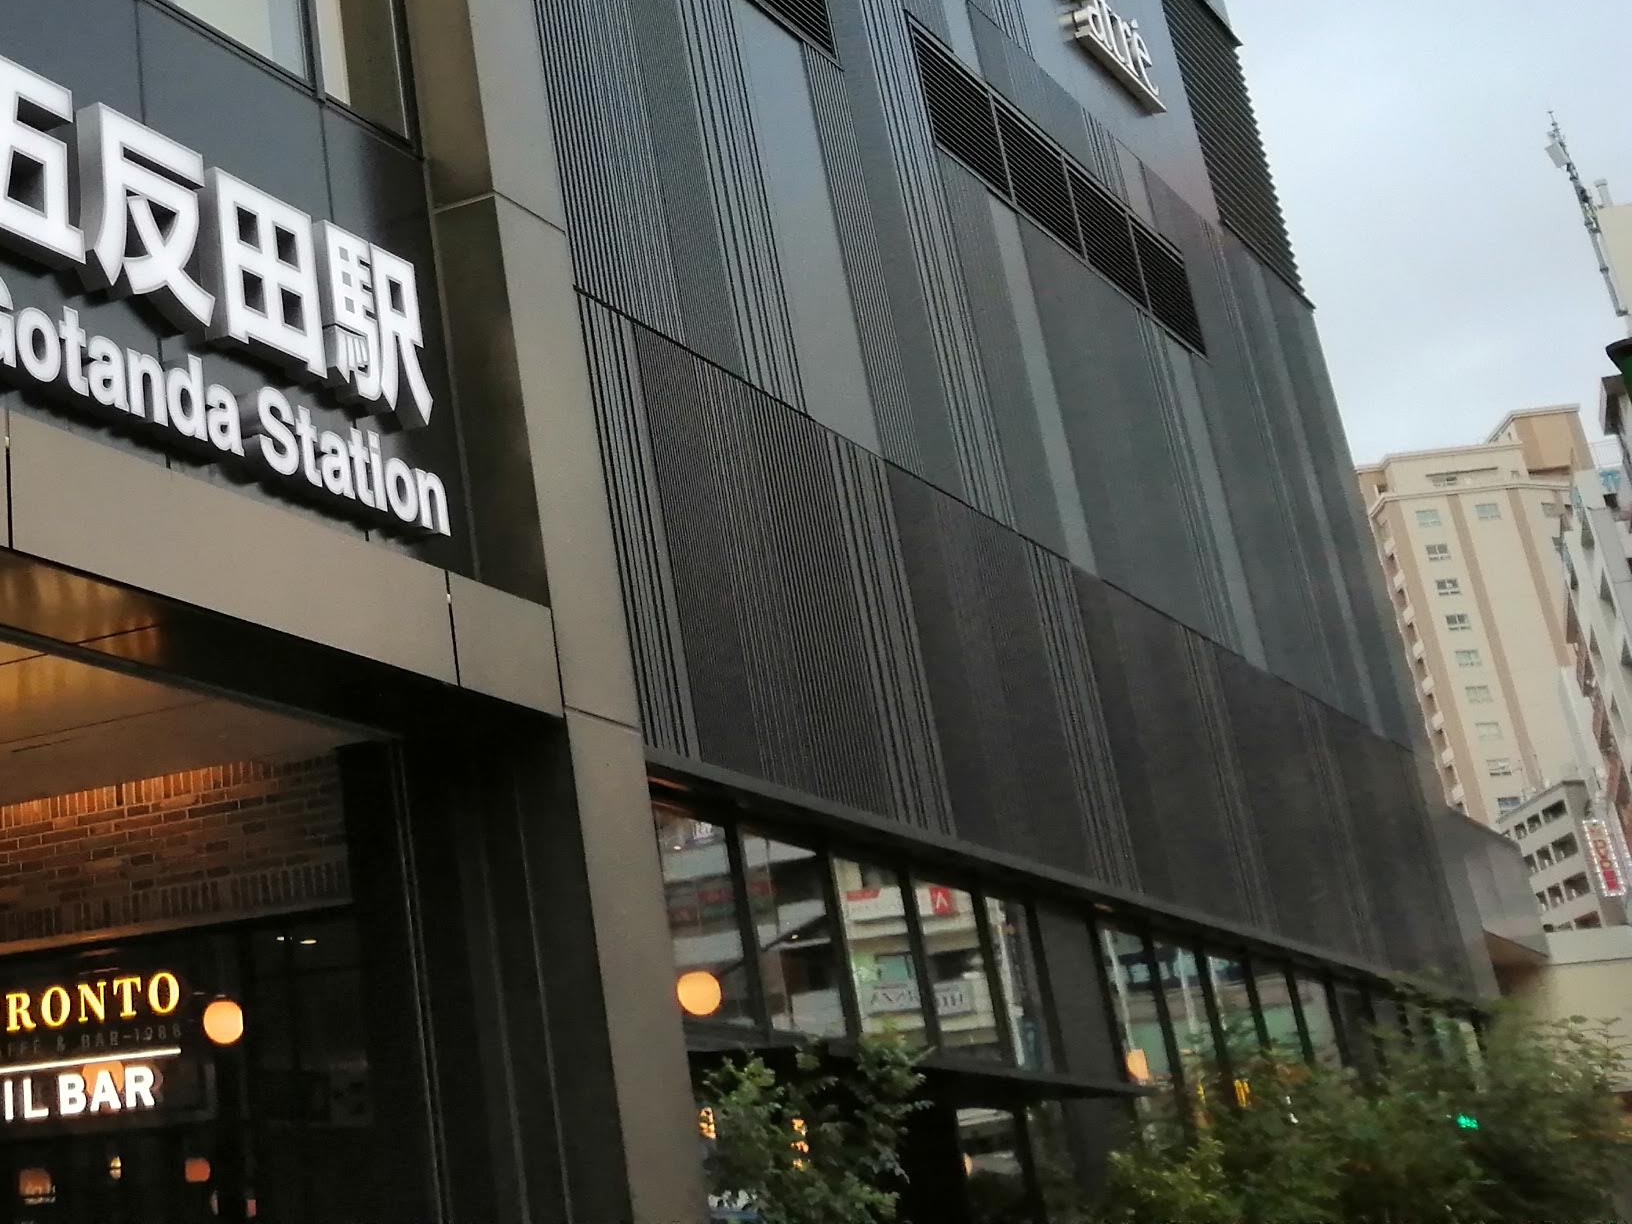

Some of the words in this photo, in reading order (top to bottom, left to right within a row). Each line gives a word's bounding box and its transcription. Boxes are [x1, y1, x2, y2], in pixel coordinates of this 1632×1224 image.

[250, 386, 451, 537] Station
[3, 1078, 50, 1122] IL
[58, 1065, 156, 1116] BAR
